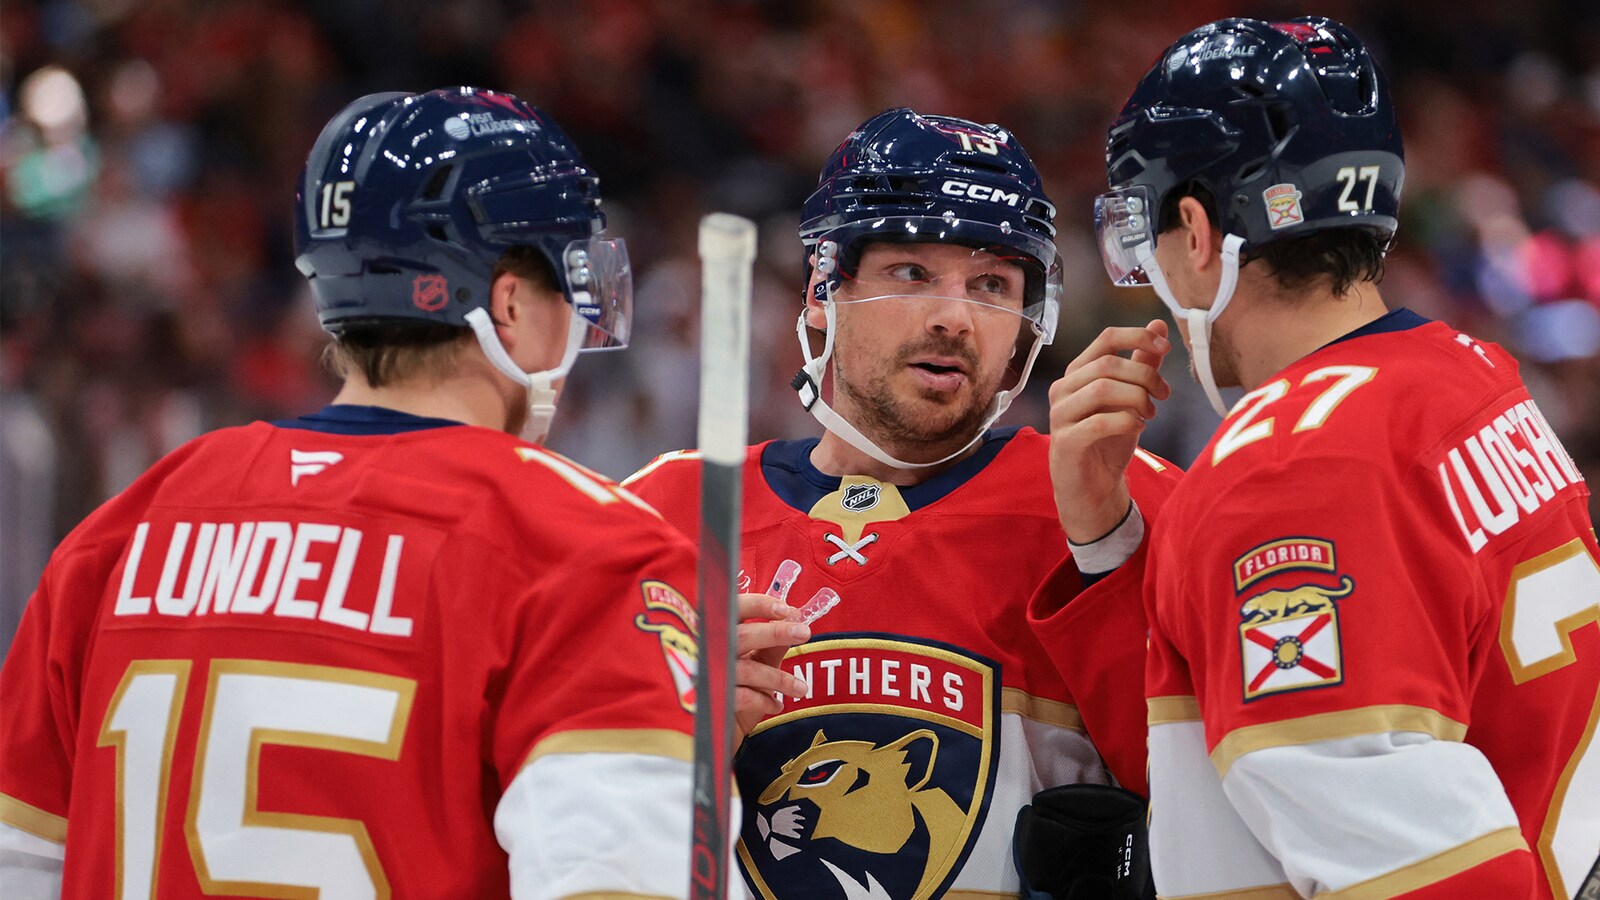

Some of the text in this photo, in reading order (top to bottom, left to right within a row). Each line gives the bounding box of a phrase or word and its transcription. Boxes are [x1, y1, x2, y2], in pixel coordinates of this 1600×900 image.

[321, 181, 356, 227] 15
[941, 180, 1020, 207] CCM
[1336, 165, 1380, 212] 27
[579, 307, 602, 315] CCM
[1211, 364, 1379, 467] 27
[850, 490, 874, 507] NHL
[114, 521, 413, 637] LUNDELL
[1245, 545, 1322, 576] FLORIDA
[774, 657, 964, 712] NTHERS
[1499, 527, 1600, 900] 2
[96, 658, 418, 900] 15
[1123, 833, 1133, 877] CCM
